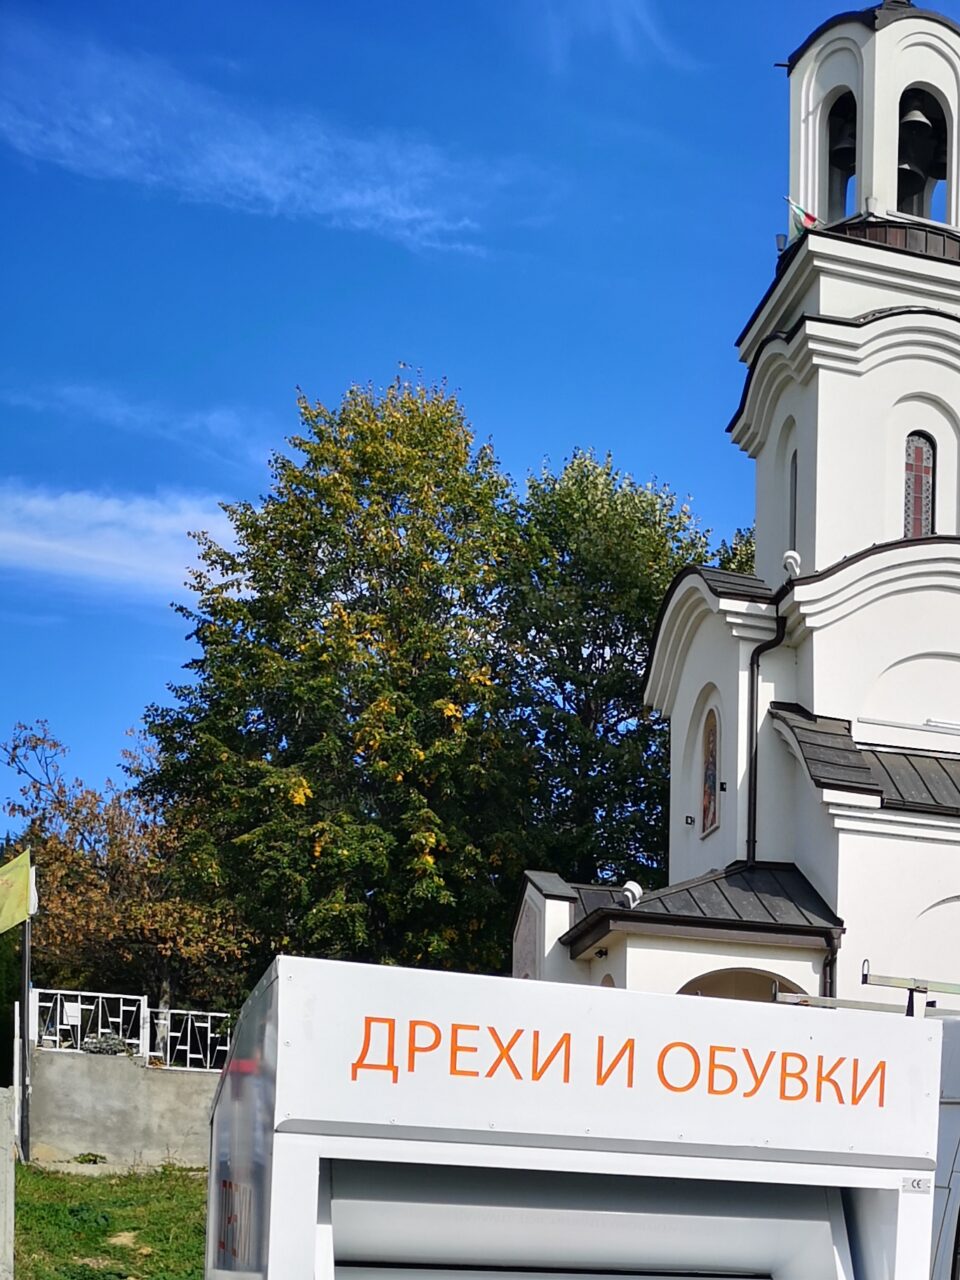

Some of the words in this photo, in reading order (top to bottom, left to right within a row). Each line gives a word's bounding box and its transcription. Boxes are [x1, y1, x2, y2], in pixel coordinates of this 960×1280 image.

[351, 1016, 572, 1084] ДРЕХИ
[596, 1035, 635, 1089] И
[657, 1041, 887, 1108] ОБУВКИ
